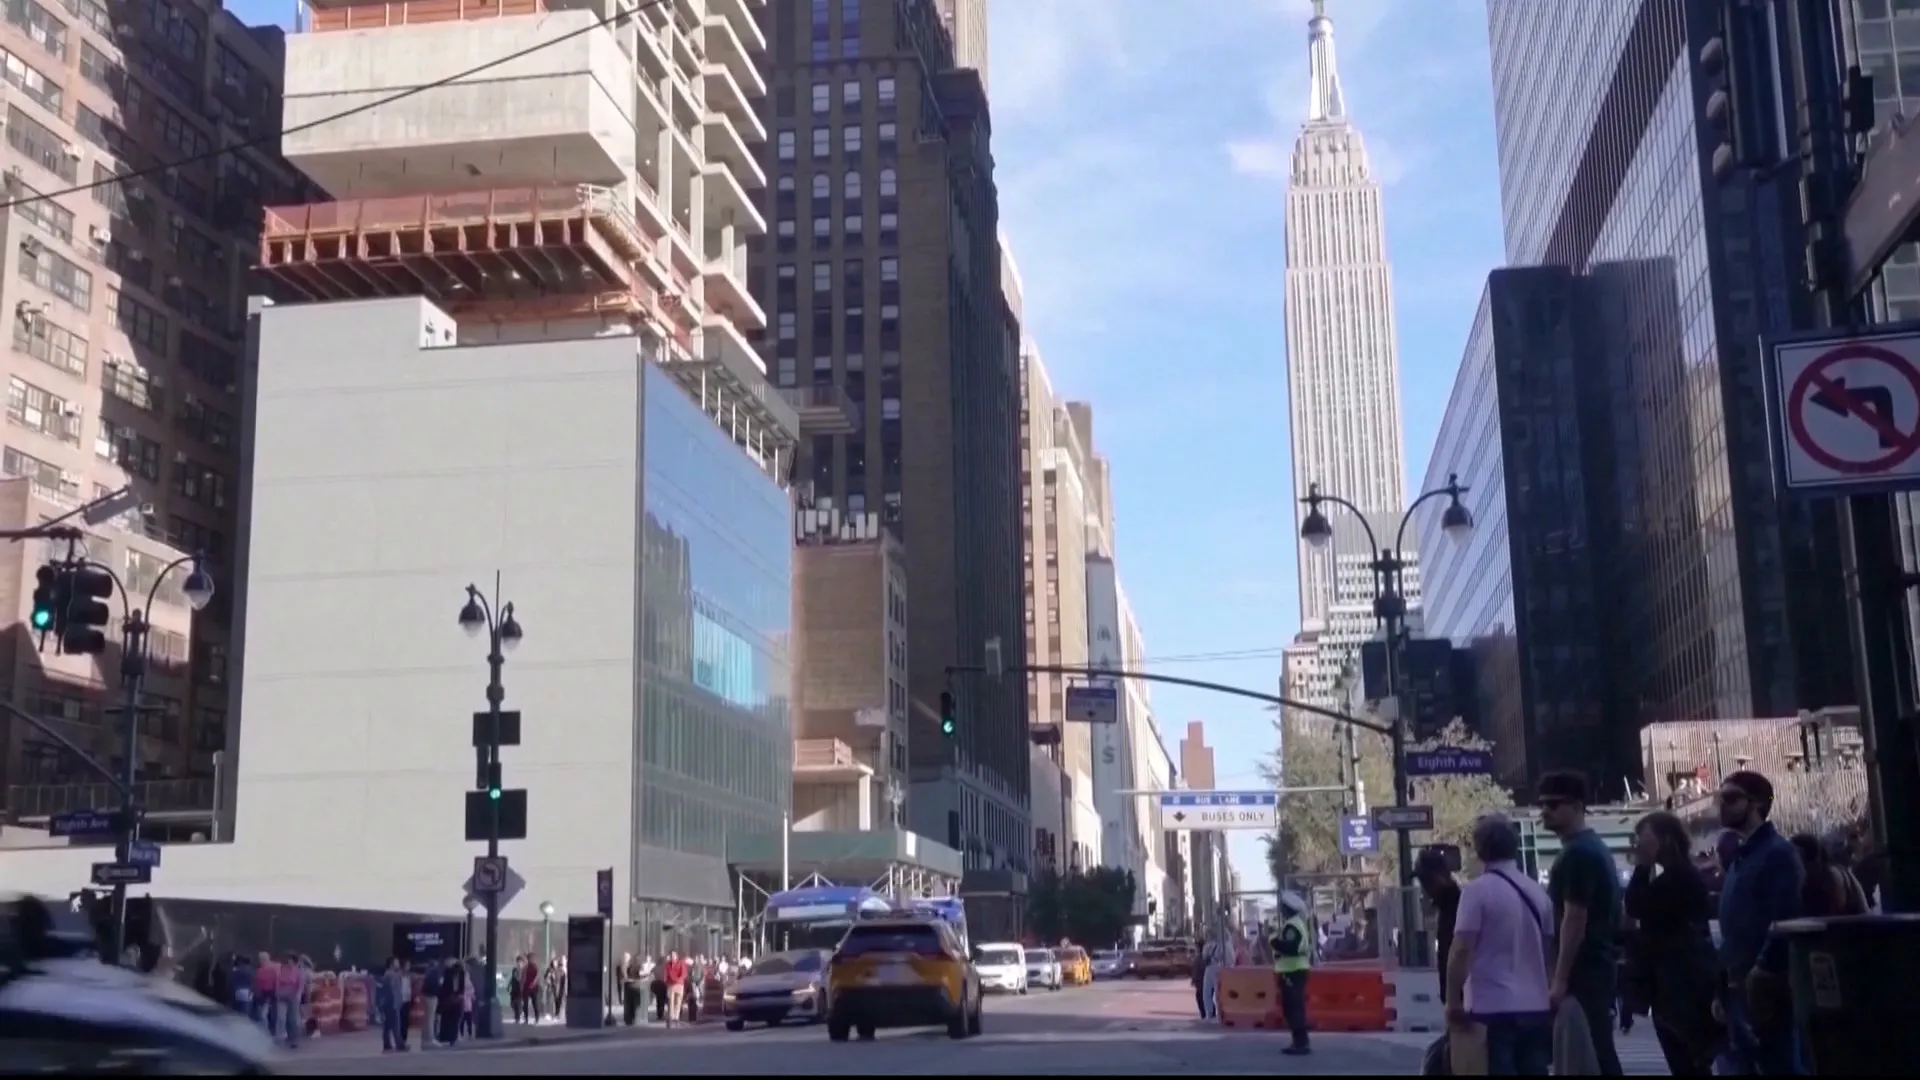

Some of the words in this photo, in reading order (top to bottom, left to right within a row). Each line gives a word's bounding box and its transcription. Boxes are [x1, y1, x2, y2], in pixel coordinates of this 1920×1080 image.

[1417, 756, 1456, 770] Eighth
[1459, 756, 1482, 768] Ave
[1201, 812, 1235, 822] BUSES
[1239, 812, 1265, 822] ONLY
